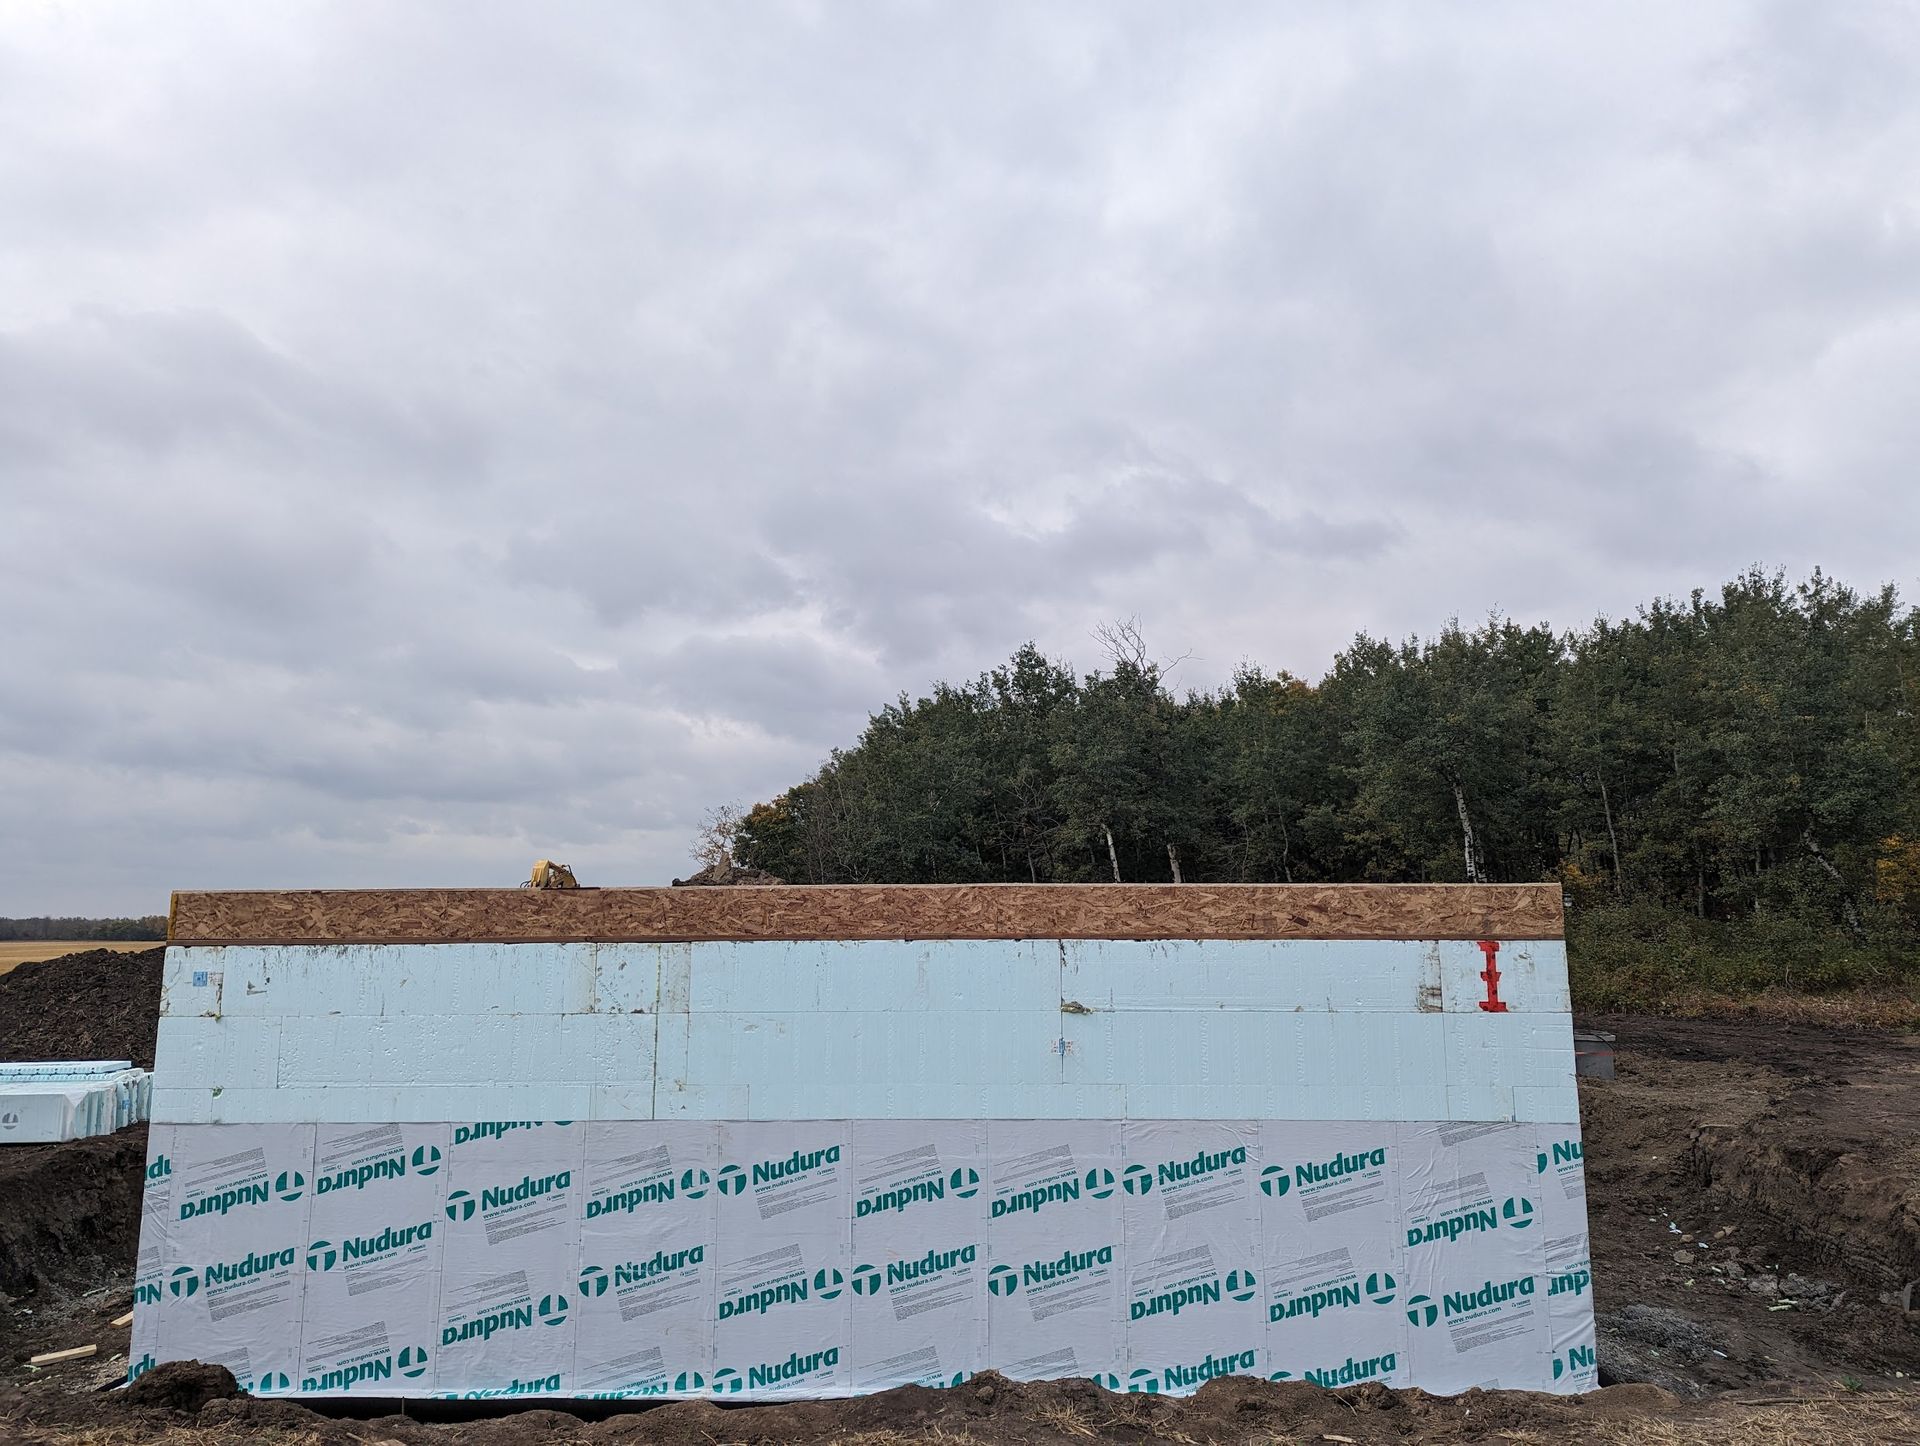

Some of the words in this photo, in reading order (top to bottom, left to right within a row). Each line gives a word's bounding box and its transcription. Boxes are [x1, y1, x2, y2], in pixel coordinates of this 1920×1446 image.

[317, 1157, 406, 1194] Nudura
[752, 1146, 841, 1184] Nudura
[1158, 1147, 1246, 1184] Nudura
[1294, 1148, 1386, 1187] Nudura
[179, 1183, 270, 1220] Nudura
[481, 1171, 571, 1210] Nudura
[586, 1179, 676, 1218] Nudura
[855, 1179, 945, 1217] Nudura
[991, 1179, 1081, 1218] Nudura
[342, 1223, 433, 1261] Nudura
[1407, 1208, 1499, 1248] Nudura
[205, 1247, 295, 1285] Nudura
[615, 1246, 704, 1285] Nudura
[887, 1246, 977, 1285] Nudura
[1023, 1247, 1113, 1285] Nudura
[718, 1280, 808, 1320] Nudura
[1130, 1279, 1221, 1320] Nudura
[1268, 1283, 1361, 1322] Nudura
[1443, 1276, 1536, 1316] Nudura
[442, 1306, 533, 1345] Nudura
[301, 1357, 392, 1393] Nudura
[749, 1347, 839, 1391] Nudura
[1163, 1349, 1255, 1391] Nudura
